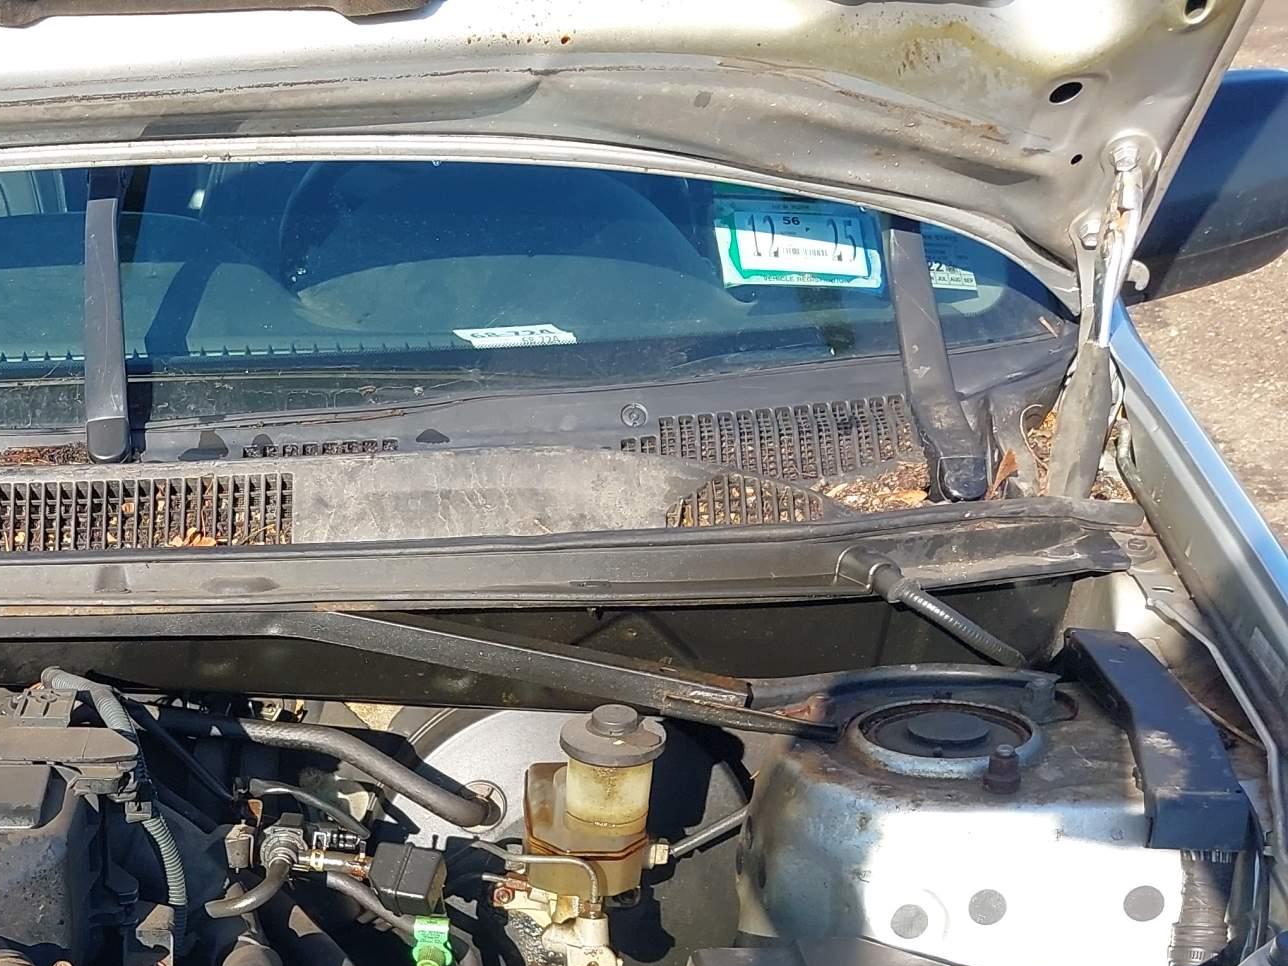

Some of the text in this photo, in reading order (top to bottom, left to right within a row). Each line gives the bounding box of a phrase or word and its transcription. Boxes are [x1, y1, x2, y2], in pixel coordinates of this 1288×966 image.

[782, 216, 800, 226] 56
[748, 214, 779, 257] 12
[827, 218, 858, 262] 25
[763, 275, 796, 283] VEHICLE
